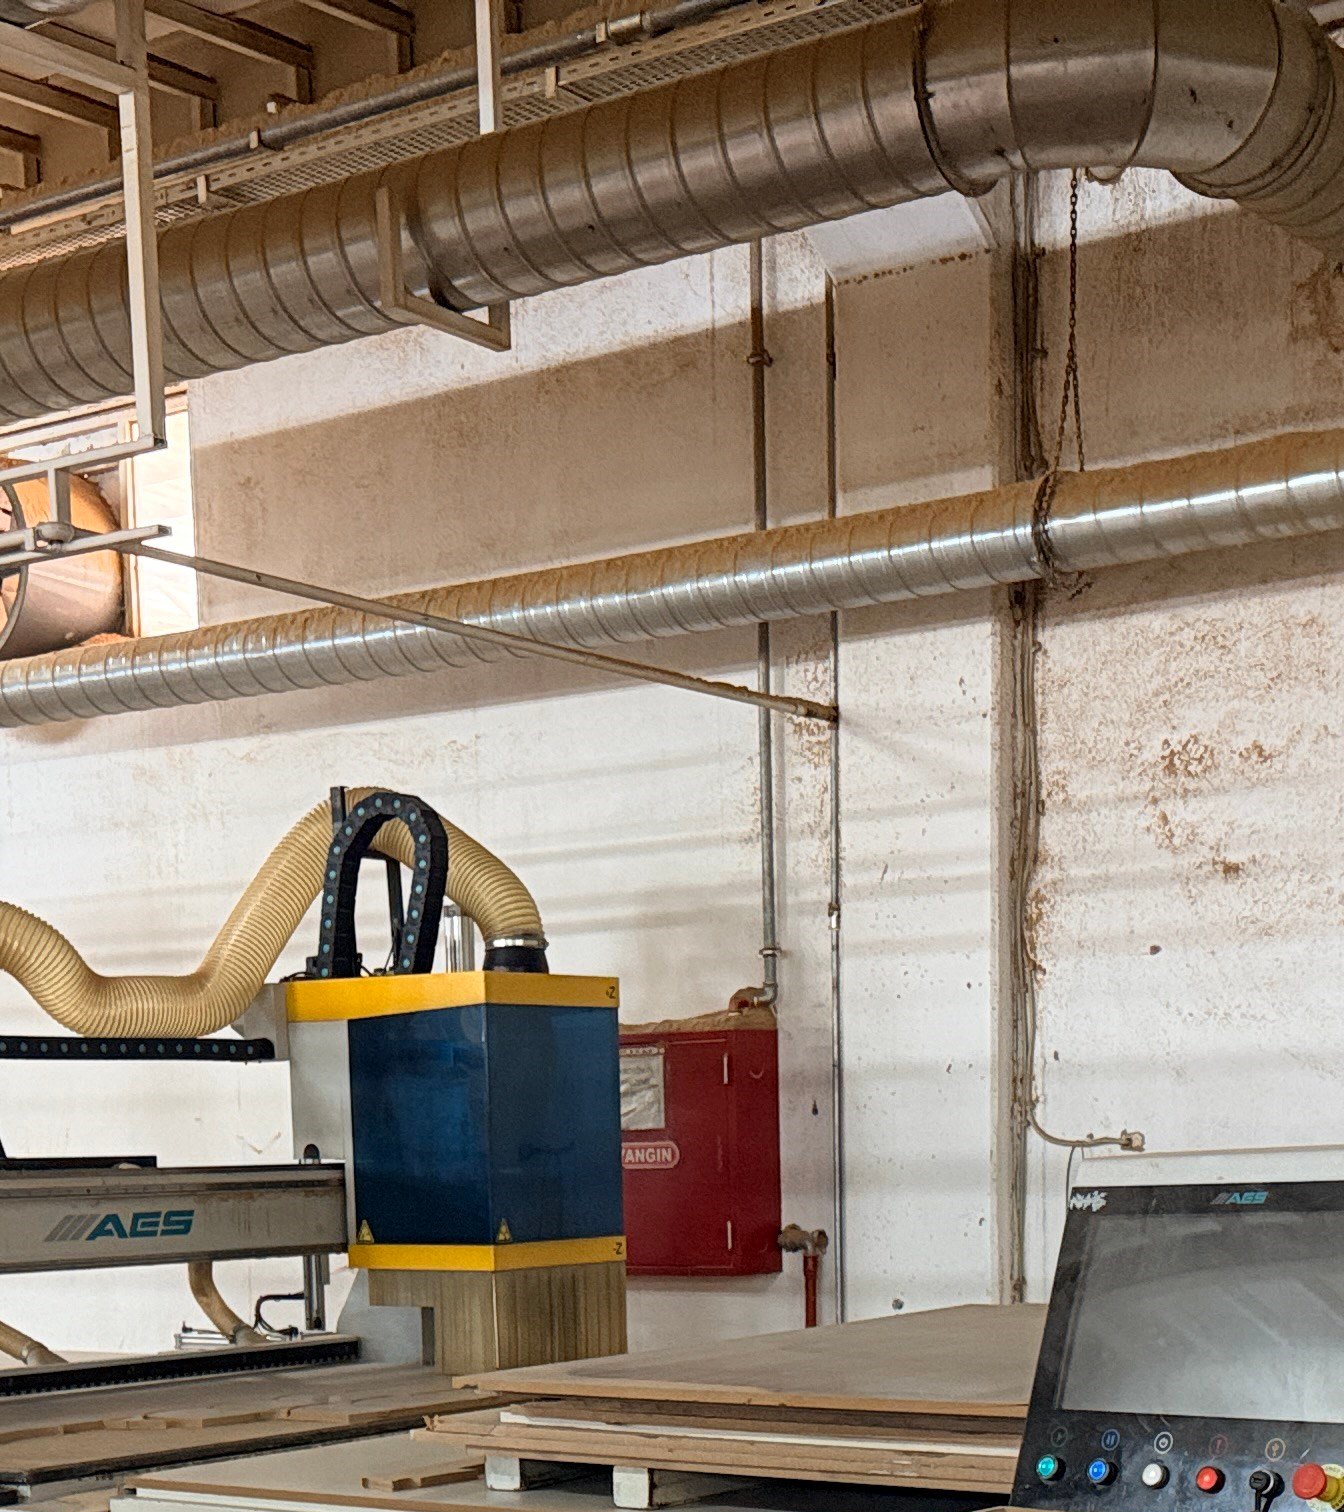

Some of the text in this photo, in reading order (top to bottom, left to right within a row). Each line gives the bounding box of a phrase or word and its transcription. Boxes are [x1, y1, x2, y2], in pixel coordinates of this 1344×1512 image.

[621, 1147, 672, 1163] ANGIN
[1225, 1191, 1269, 1204] AES
[85, 1210, 195, 1241] AES
